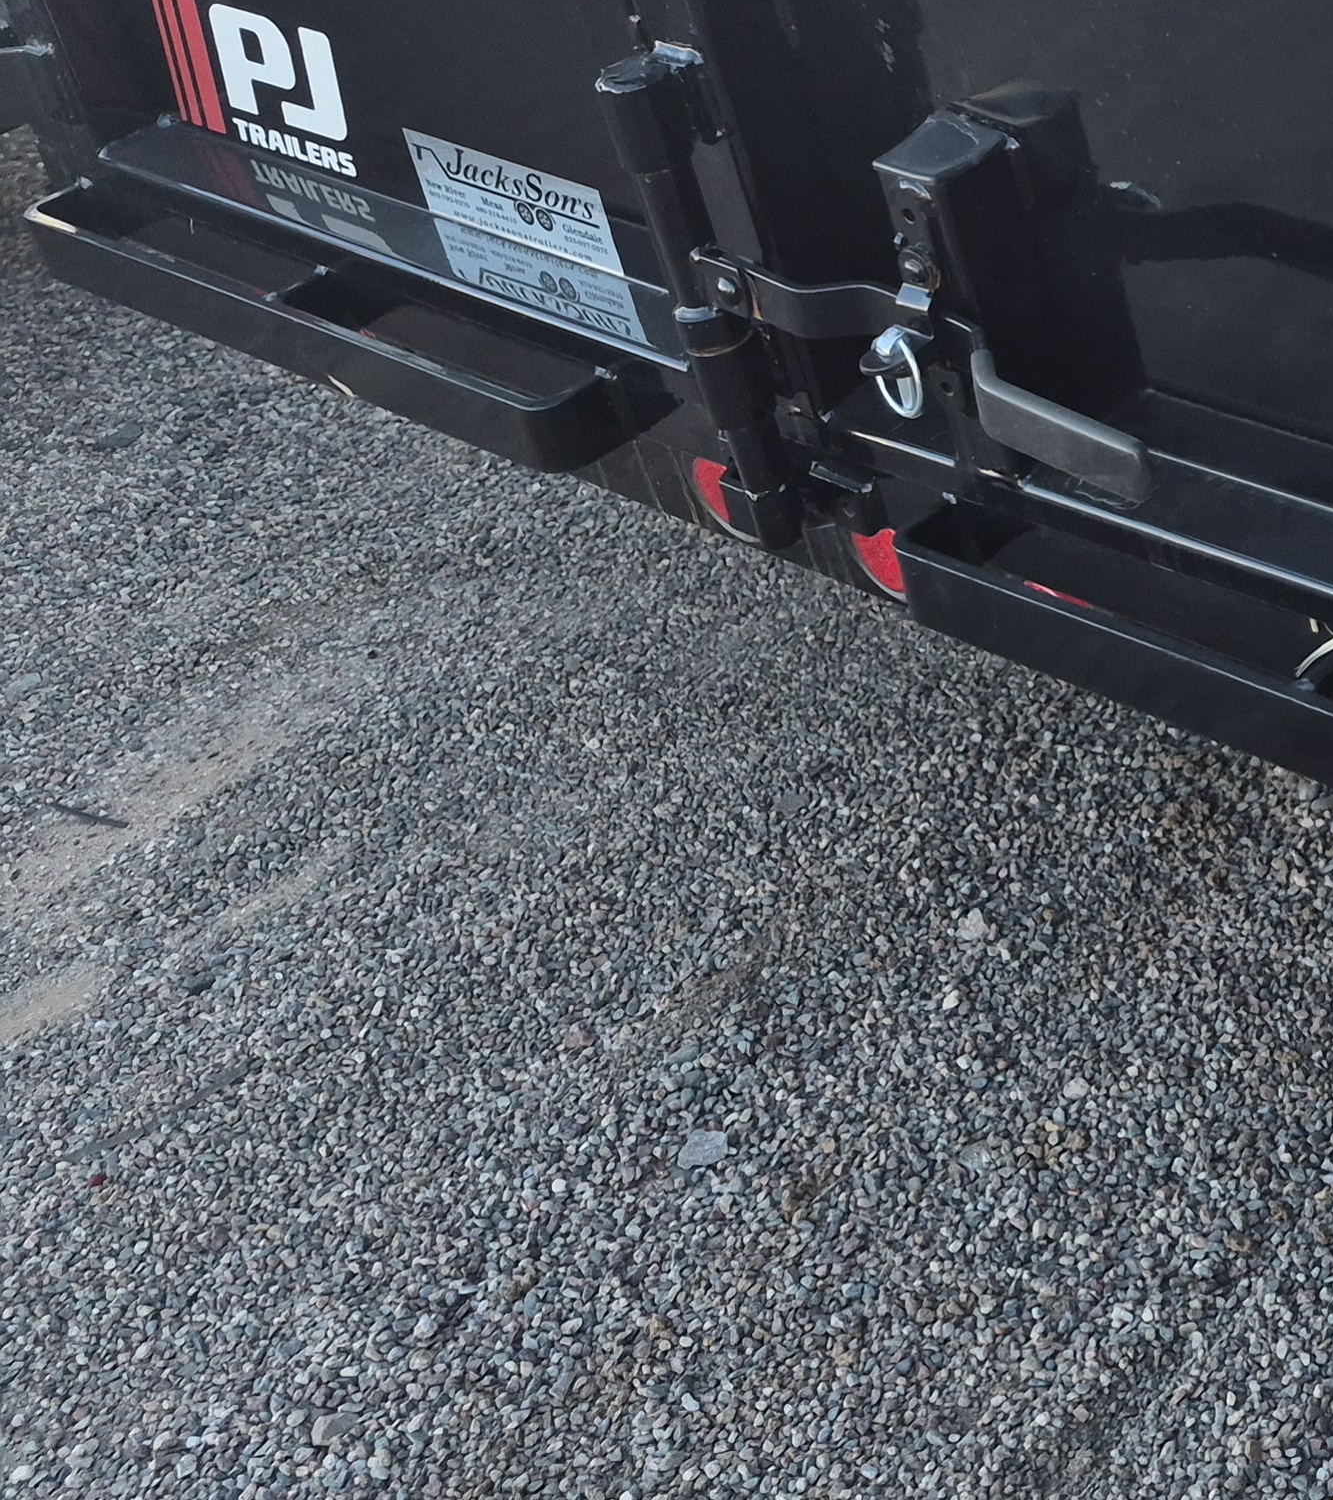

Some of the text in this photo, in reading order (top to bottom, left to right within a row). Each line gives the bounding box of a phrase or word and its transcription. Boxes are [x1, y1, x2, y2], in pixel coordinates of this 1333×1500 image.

[208, 2, 348, 141] PJ
[232, 116, 358, 178] TRAILERS
[446, 148, 595, 220] JacksSon's
[560, 221, 604, 245] Glendale
